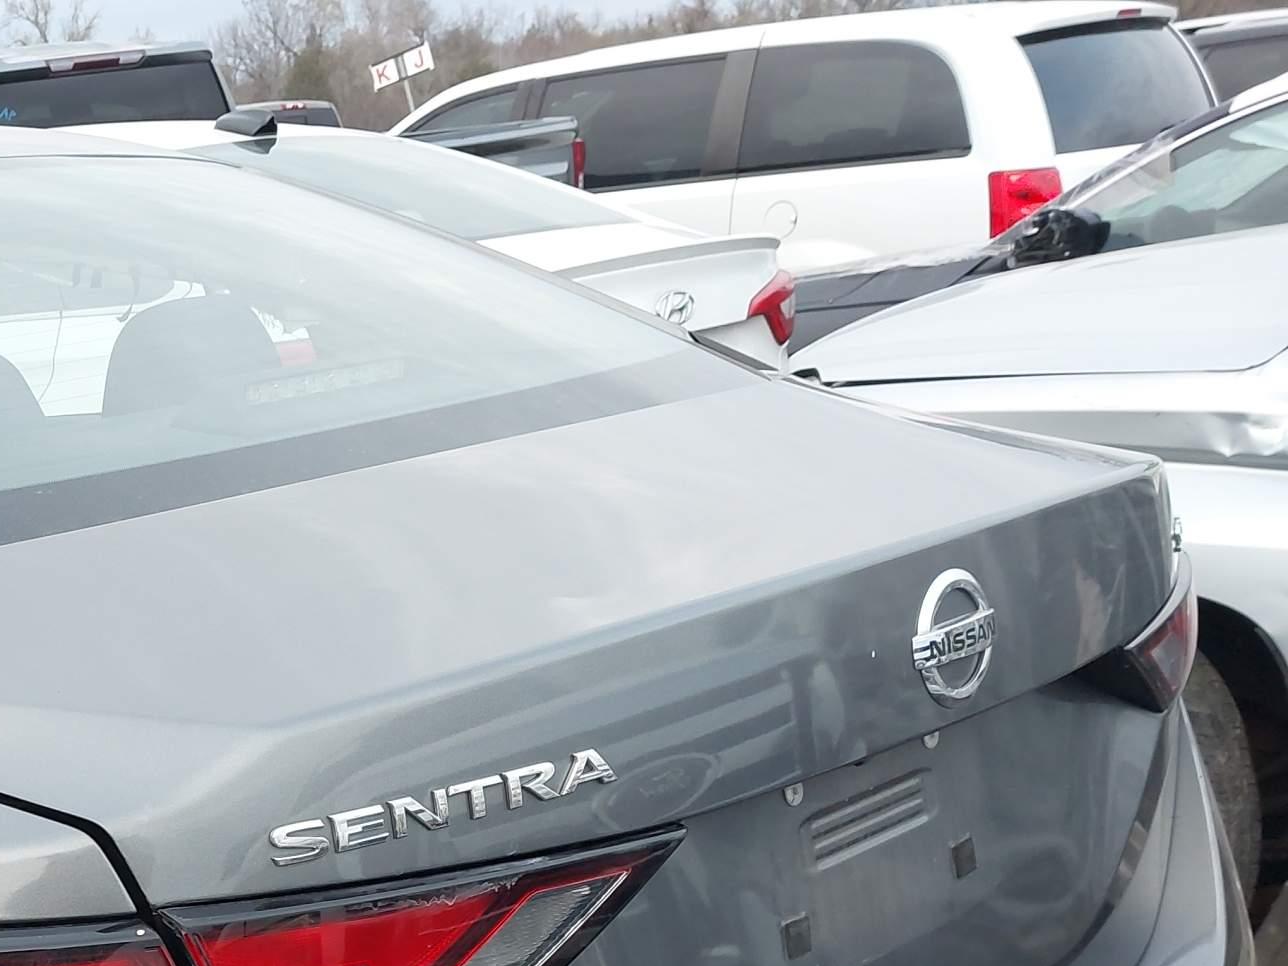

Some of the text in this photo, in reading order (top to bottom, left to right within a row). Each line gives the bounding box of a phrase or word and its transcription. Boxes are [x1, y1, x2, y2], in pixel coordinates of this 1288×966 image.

[376, 49, 424, 84] K J
[928, 616, 996, 660] NISSAN
[269, 748, 616, 866] SENTRA
